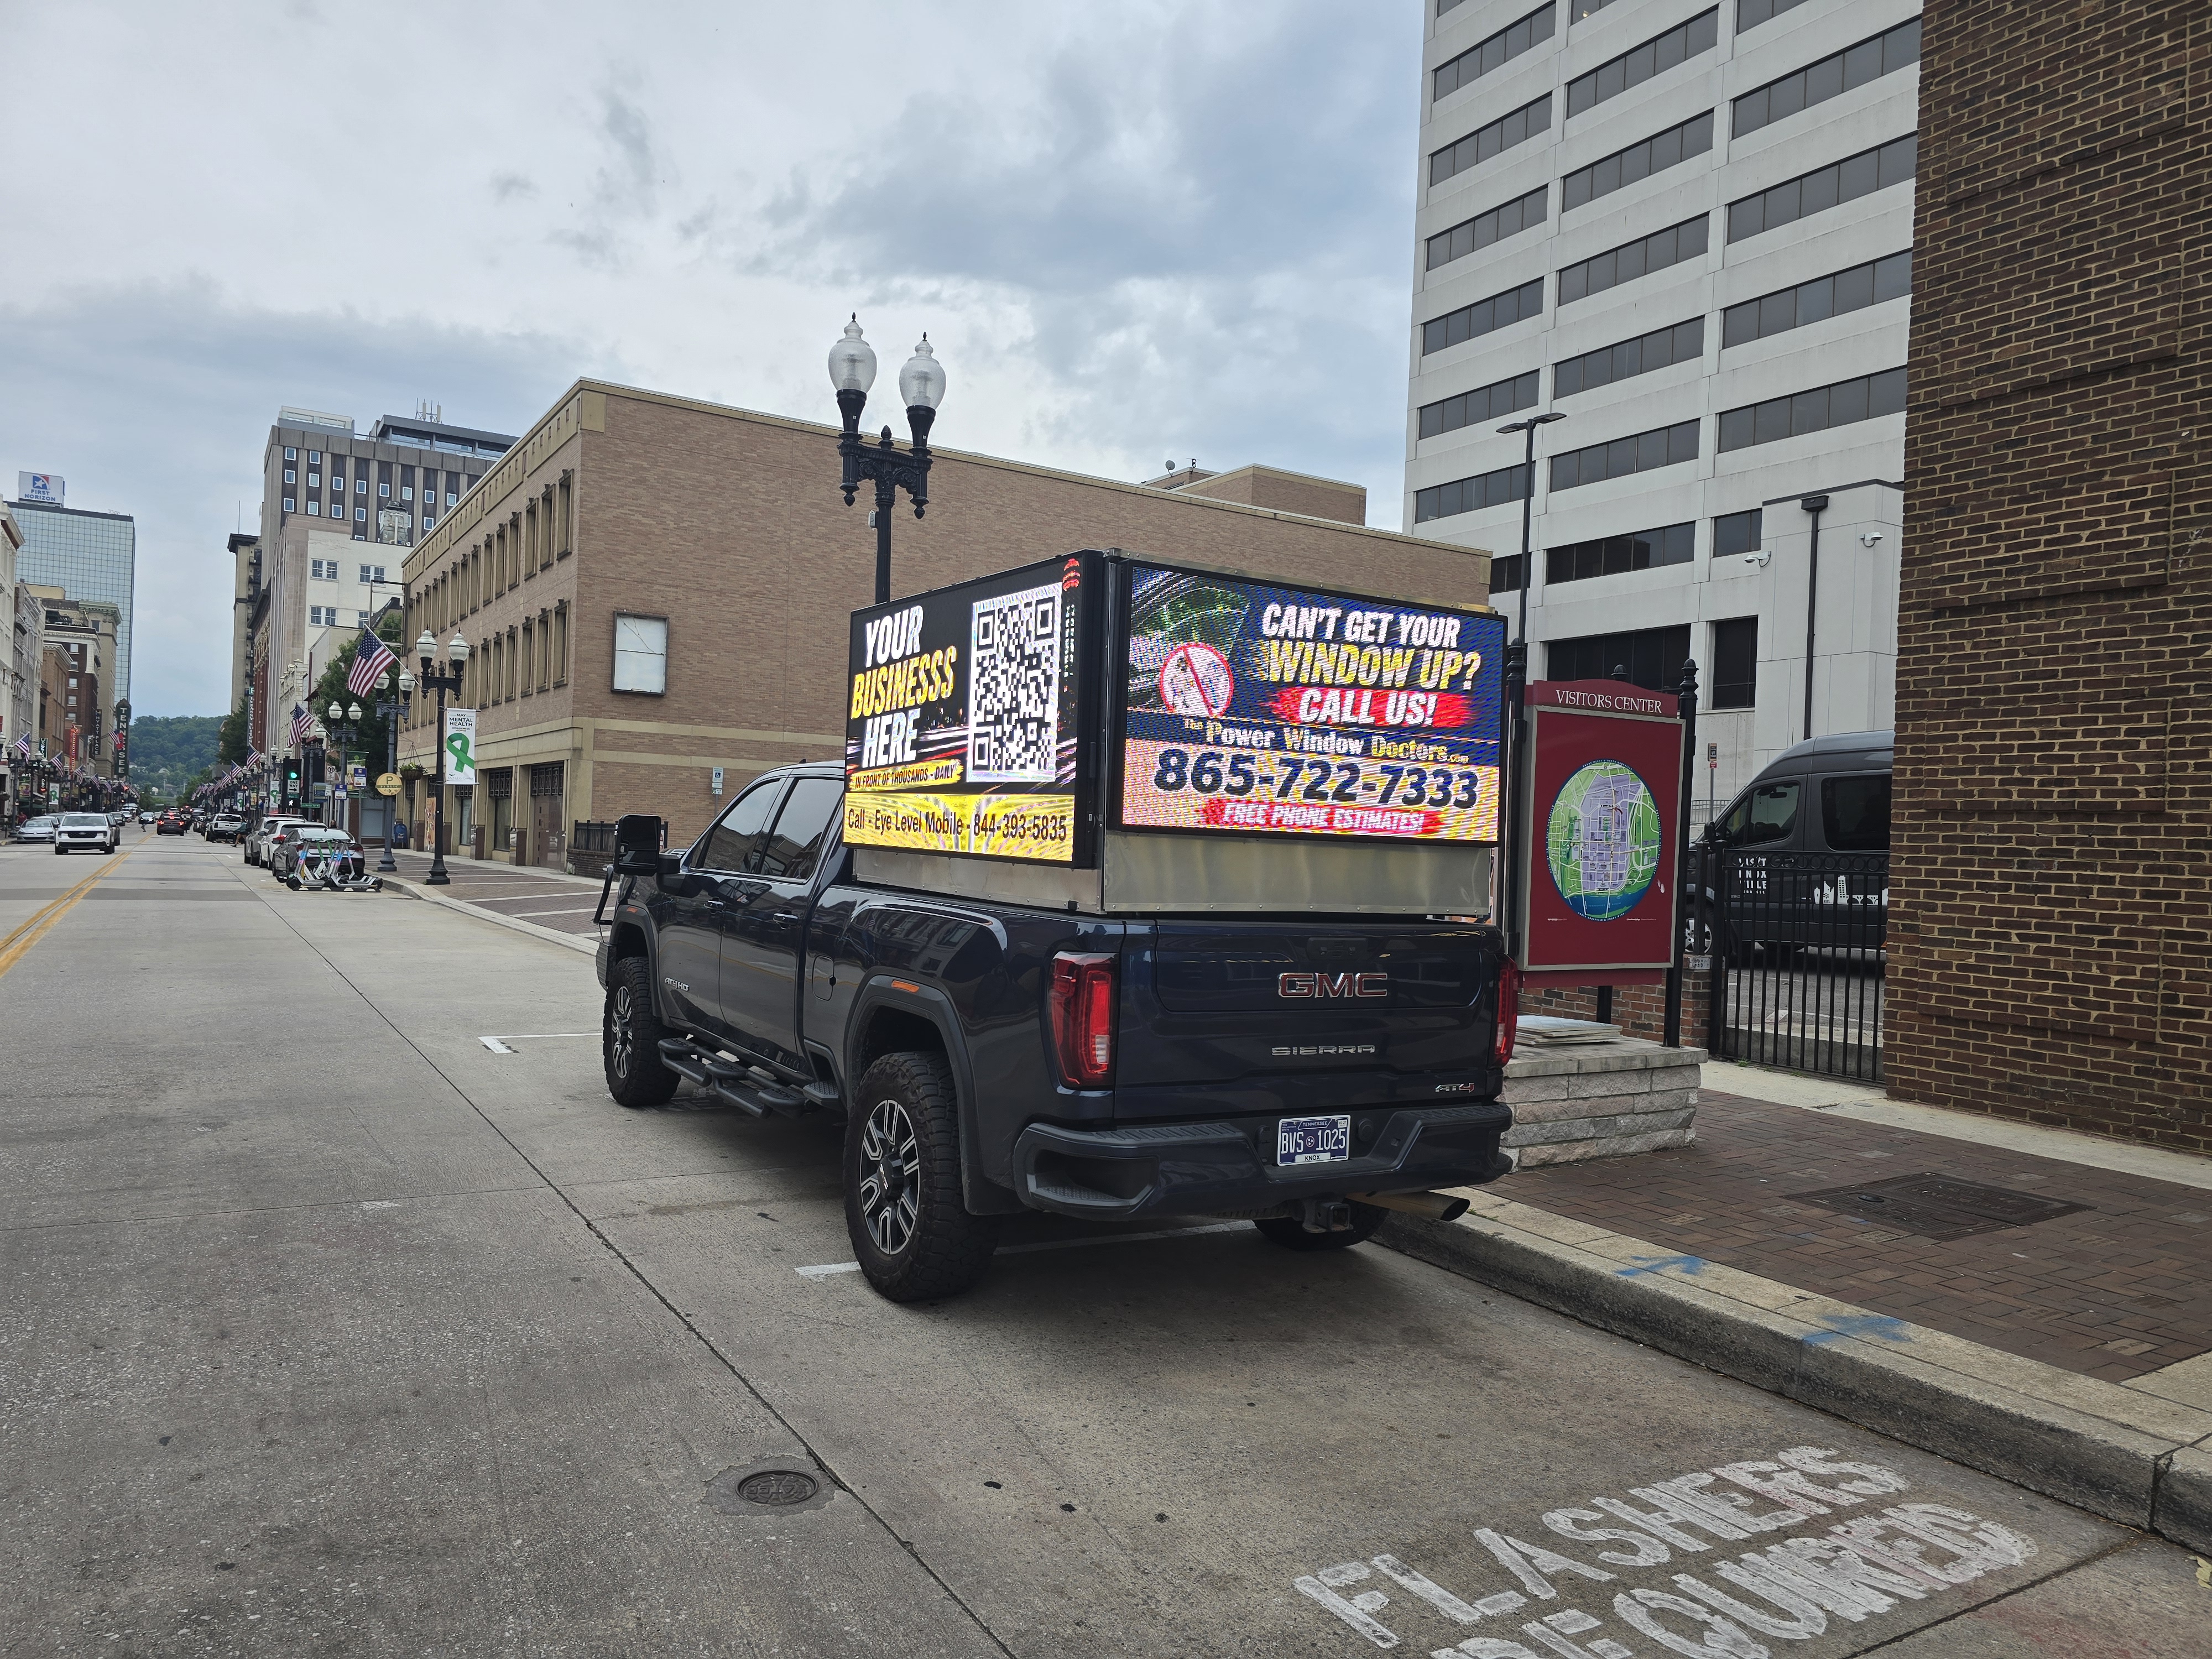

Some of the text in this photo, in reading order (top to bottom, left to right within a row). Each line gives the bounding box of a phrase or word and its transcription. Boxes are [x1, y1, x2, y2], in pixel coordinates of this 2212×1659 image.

[24, 493, 56, 502] HORIZON
[864, 605, 924, 668] YOUR
[1262, 603, 1461, 648] CAN'T GET YOUR
[1269, 639, 1481, 690] WINDOW UP?
[851, 645, 957, 720] BUSINESSS
[1298, 688, 1438, 726] CALL US!
[1556, 690, 1662, 713] VISITORS CENTER
[861, 707, 922, 769] HERE
[1184, 718, 1203, 731] The
[1206, 721, 1276, 748] Power
[1282, 726, 1365, 755] Window
[386, 776, 393, 784] P
[855, 775, 862, 789] IN
[862, 774, 881, 789] FRONT
[882, 772, 889, 786] OF
[891, 768, 929, 785] THOUSANDS
[935, 764, 955, 781] DAILY
[1154, 748, 1479, 810] 865-722-7333
[848, 808, 865, 830] Call
[874, 810, 891, 836] Eye
[895, 811, 921, 833] Level
[925, 811, 963, 836] Mobile
[973, 812, 1067, 842] 844-393-5835
[1223, 802, 1425, 832] FREE PHONE ESTIMATES!
[1278, 972, 1387, 998] GMC
[1271, 1045, 1375, 1056] SIERRA
[1435, 1083, 1475, 1093] AT4
[1281, 1129, 1346, 1154] BVS 1025
[1293, 1444, 1910, 1649] FLASHERS
